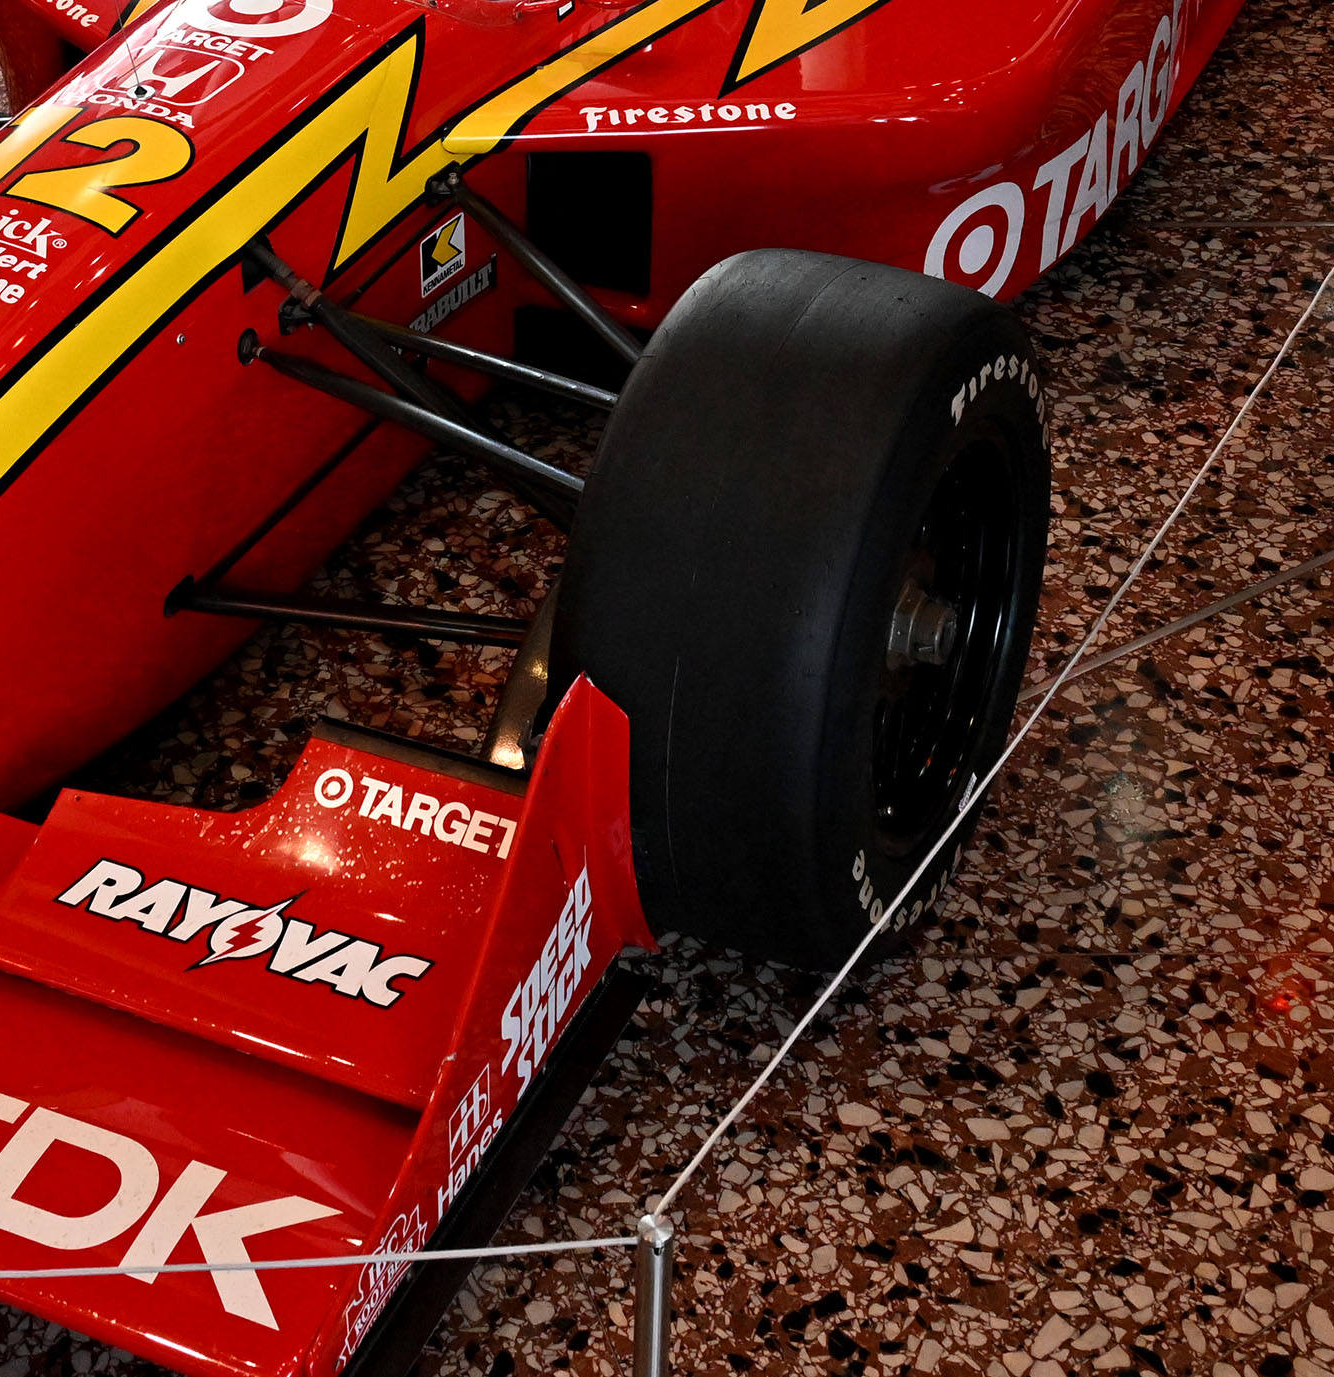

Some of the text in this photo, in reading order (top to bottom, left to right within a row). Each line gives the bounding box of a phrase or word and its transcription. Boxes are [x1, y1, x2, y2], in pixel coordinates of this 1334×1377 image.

[159, 23, 274, 62] TARGET
[578, 99, 797, 134] Firestone
[422, 258, 464, 297] KENNAMETAL
[355, 775, 519, 861] TARGET
[58, 858, 431, 1008] RAYOVAC
[437, 1106, 503, 1224] Hanes
[354, 1279, 386, 1338] ROOT
